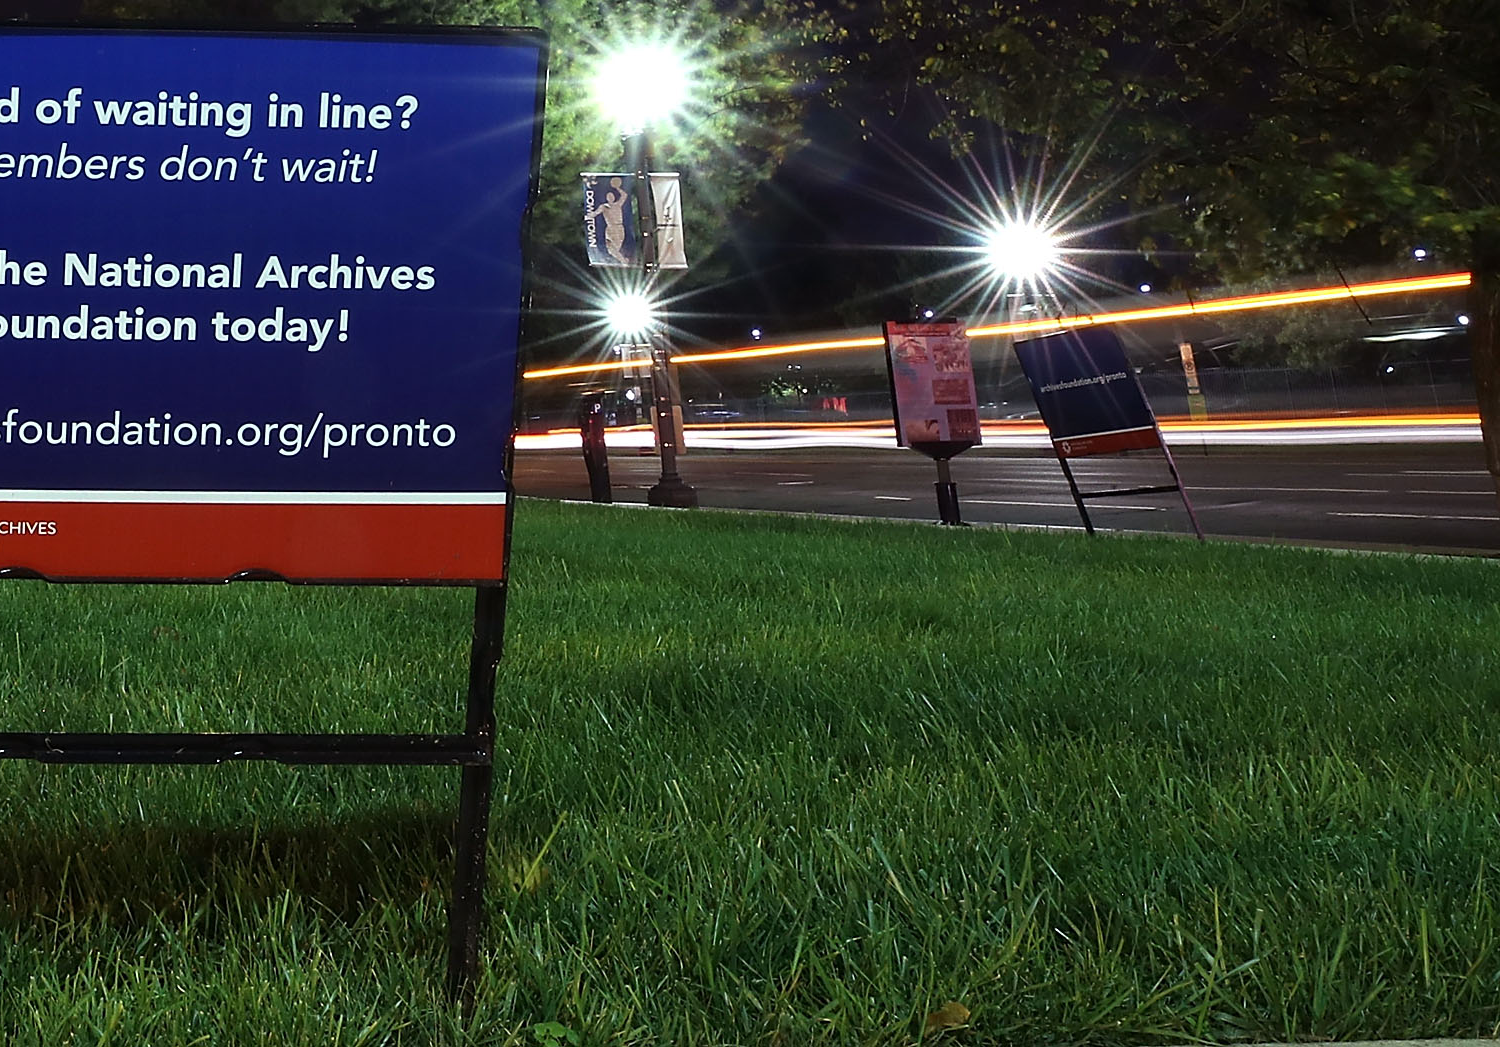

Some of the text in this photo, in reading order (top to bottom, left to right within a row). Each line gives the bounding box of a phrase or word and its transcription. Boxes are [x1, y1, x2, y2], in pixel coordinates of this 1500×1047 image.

[36, 88, 83, 124] of
[94, 92, 252, 138] waiting
[269, 93, 304, 128] in
[320, 93, 419, 130] line?
[282, 149, 378, 183] wait!
[64, 253, 243, 289] National
[256, 254, 435, 290] Archives
[212, 307, 349, 352] today!
